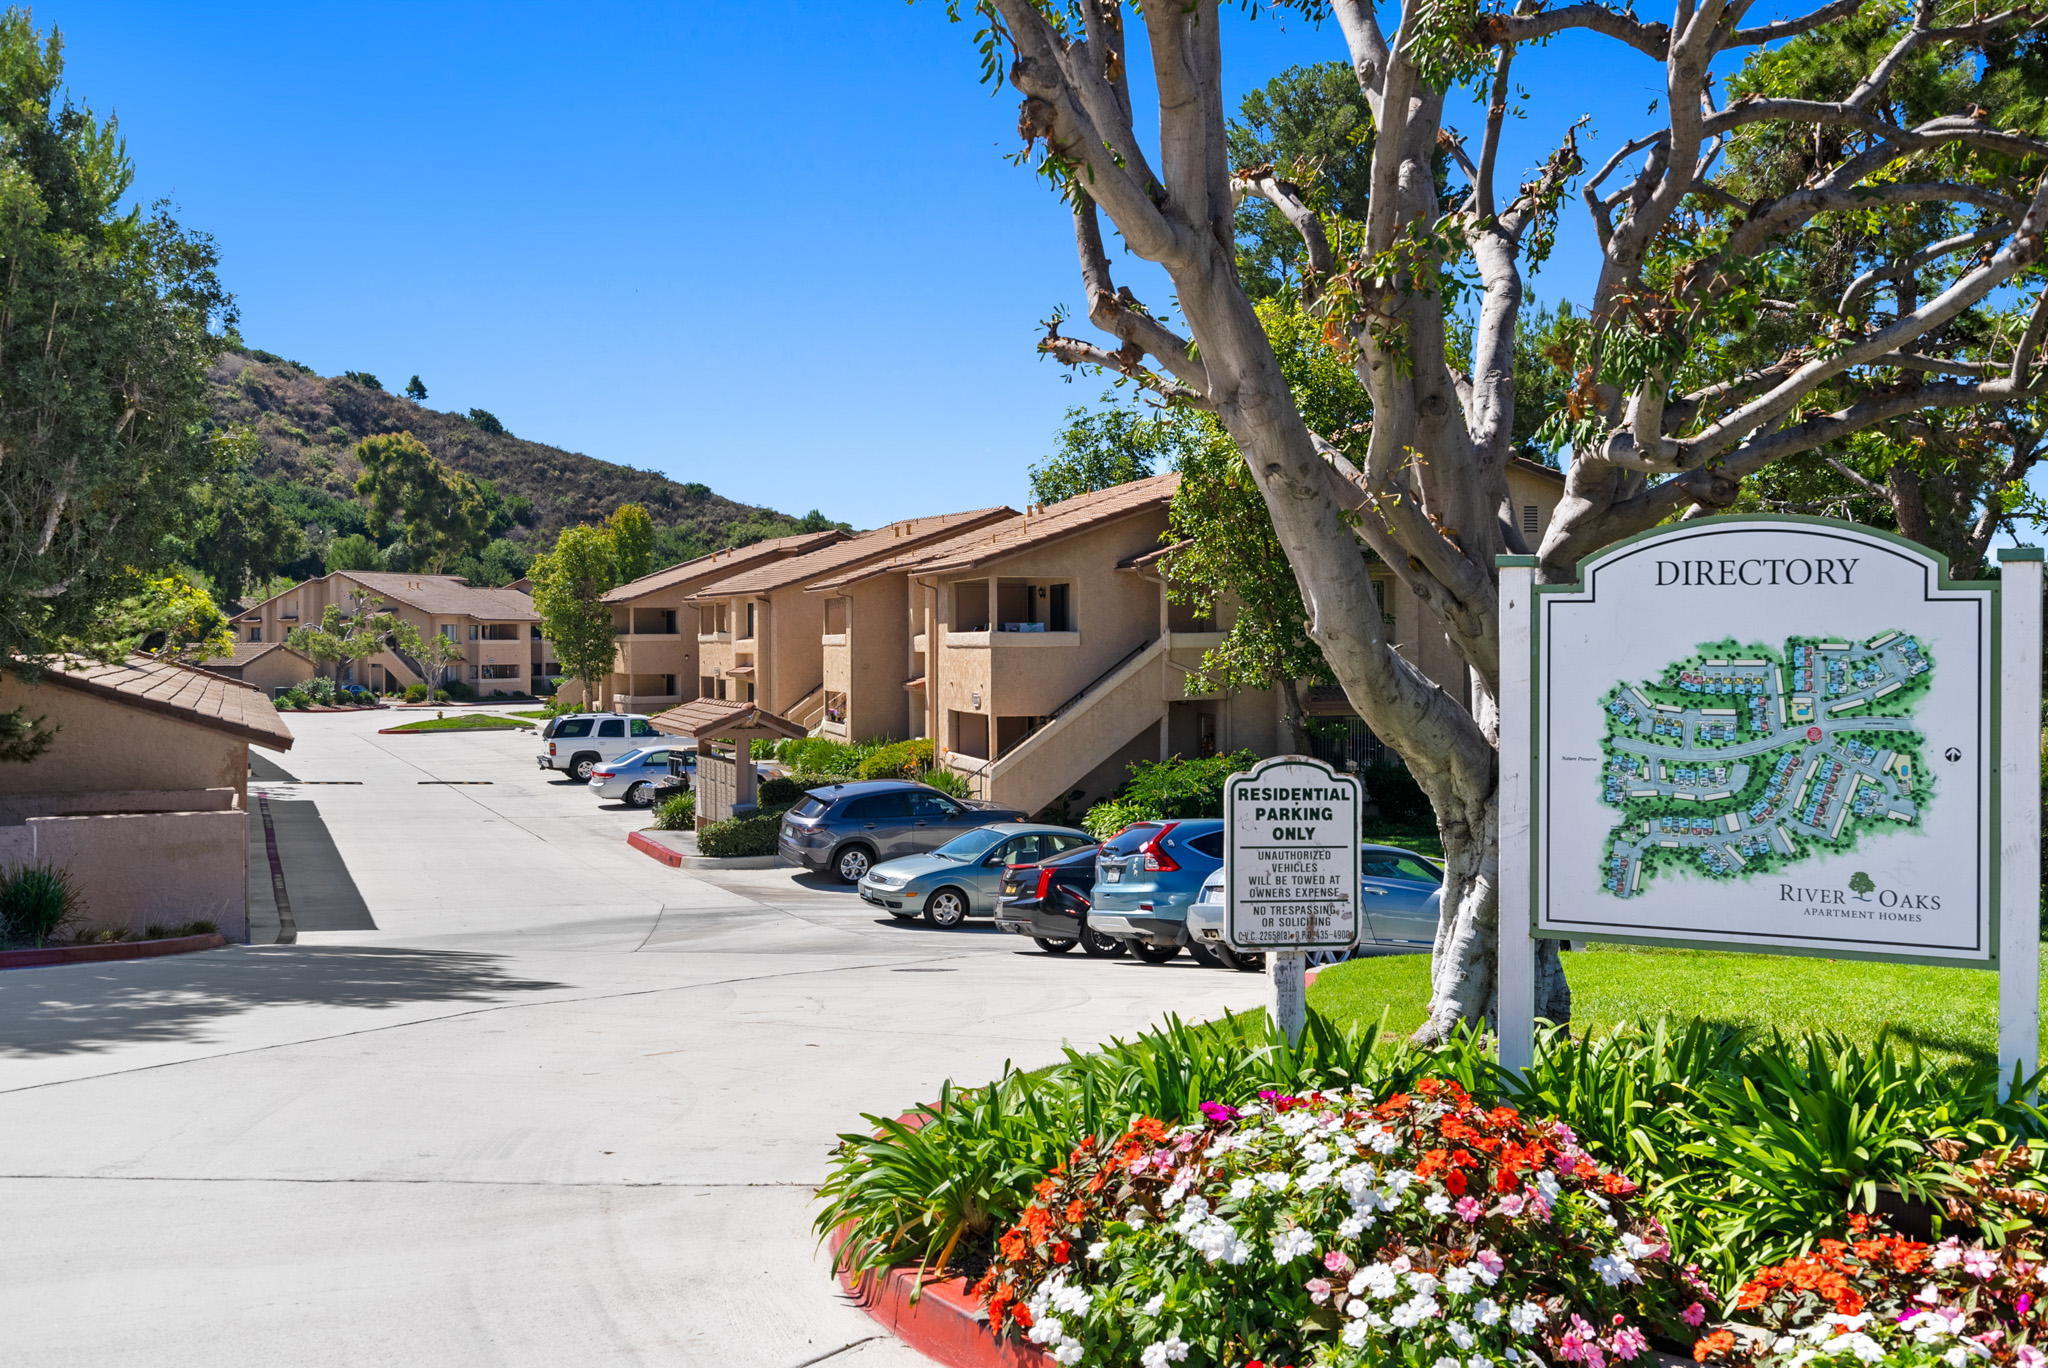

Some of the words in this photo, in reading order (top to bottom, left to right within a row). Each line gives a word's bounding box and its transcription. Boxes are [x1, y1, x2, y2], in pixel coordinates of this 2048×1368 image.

[1655, 558, 1860, 586] DIRECTORY
[1238, 788, 1350, 801] RESIDENTIAL
[1255, 807, 1333, 821] PARKING
[1272, 827, 1316, 840] ONLY
[1258, 850, 1331, 861] UNAUTHORIZED
[1271, 863, 1318, 873] VEHICLES
[1248, 875, 1271, 886] WILL
[1275, 875, 1288, 886] BE
[1292, 875, 1325, 885] TOWED
[1329, 875, 1341, 885] AT
[1249, 888, 1291, 898] OWNERS
[1295, 887, 1340, 898] EXPENSE
[1779, 883, 1846, 905] RIVER
[1879, 889, 1941, 911] OAKS
[1253, 905, 1266, 916] NO
[1270, 905, 1336, 916] TRESPASSING
[1803, 907, 1875, 920] APARTMENT
[1879, 912, 1922, 923] HOMES
[1261, 917, 1274, 928] OR
[1279, 917, 1331, 927] SOLICITING
